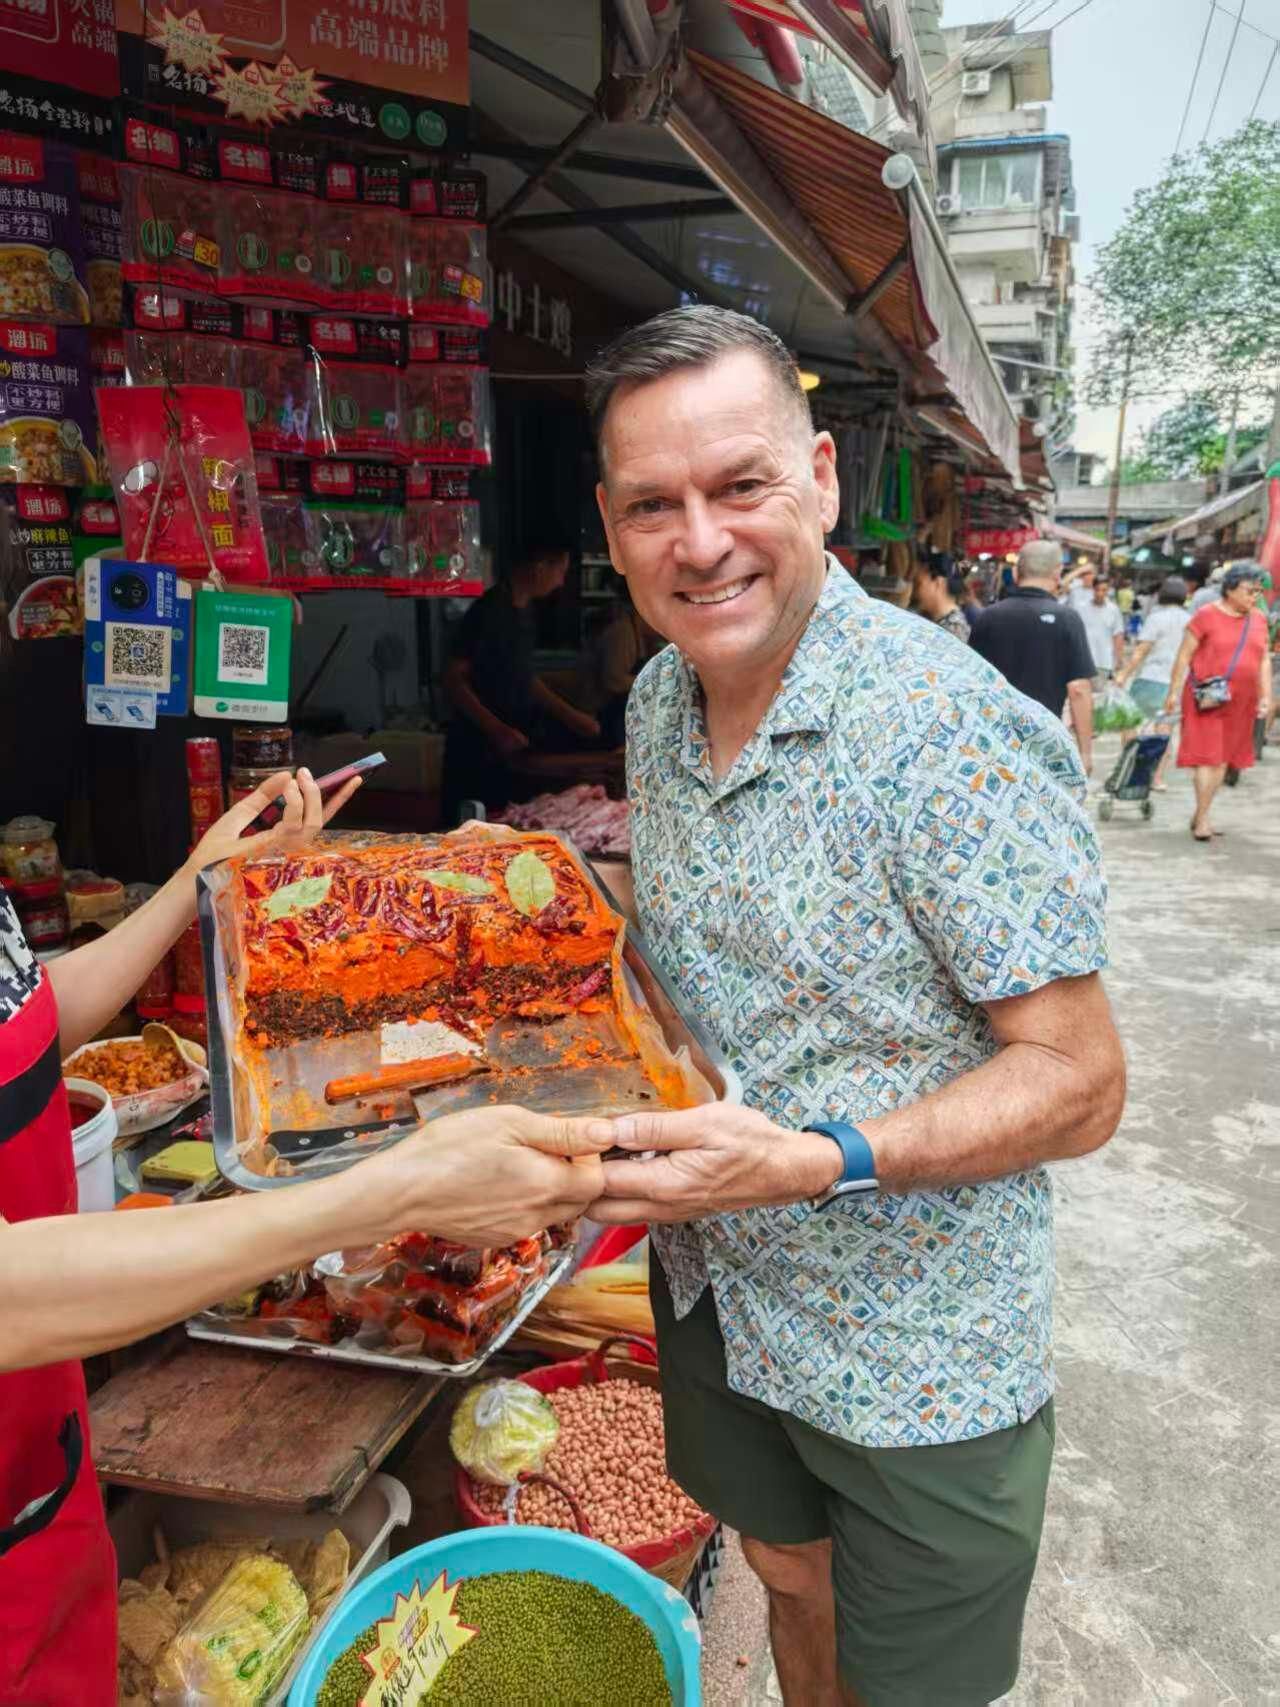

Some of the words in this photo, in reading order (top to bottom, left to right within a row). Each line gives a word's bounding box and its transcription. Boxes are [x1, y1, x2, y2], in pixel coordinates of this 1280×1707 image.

[71, 21, 117, 56] 高端
[309, 8, 449, 73] 高端品牌
